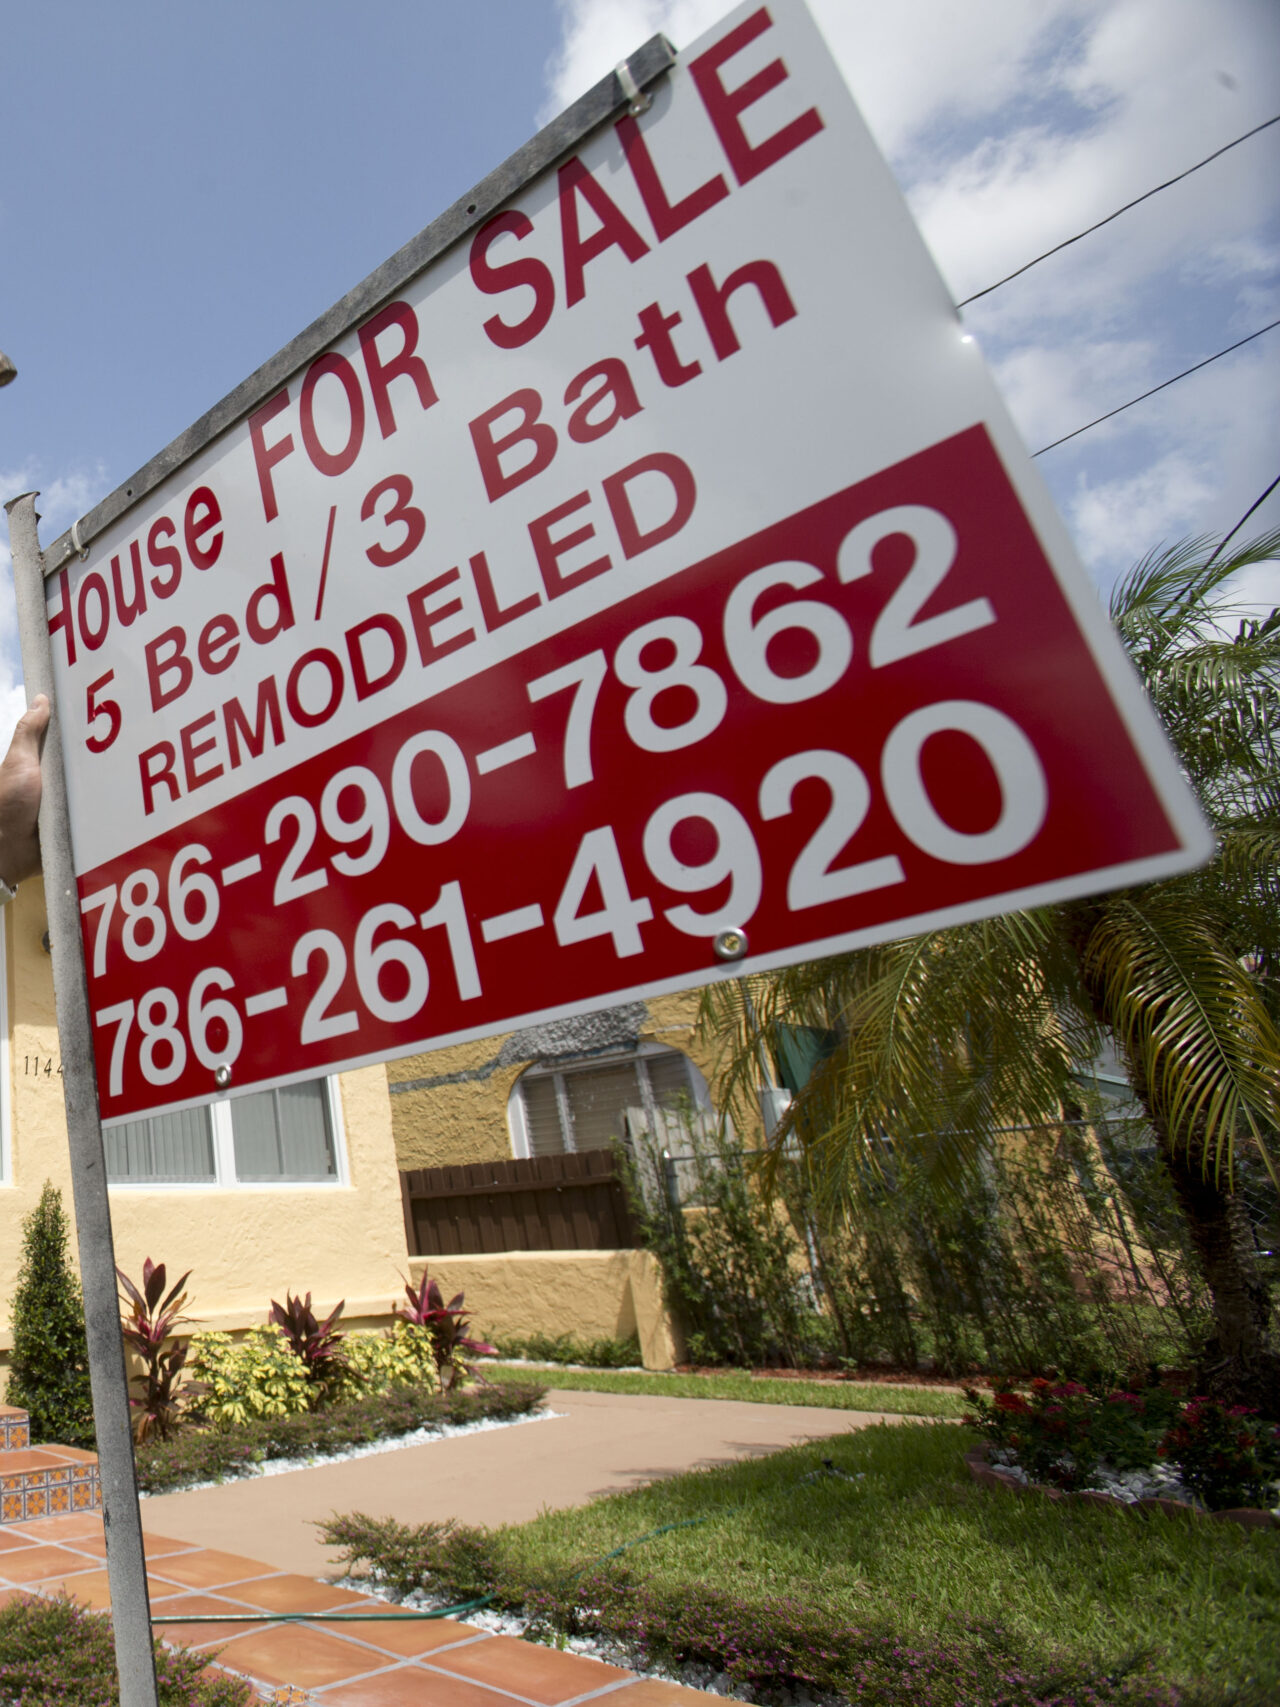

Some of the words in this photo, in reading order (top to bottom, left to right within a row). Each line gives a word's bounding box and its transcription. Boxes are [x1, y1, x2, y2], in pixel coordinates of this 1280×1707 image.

[48, 486, 224, 667] House
[247, 301, 440, 523] FOR
[469, 6, 825, 350] SALE
[85, 669, 122, 754] 5
[468, 259, 798, 503] Bath
[81, 505, 997, 979] 786-290-7862
[138, 452, 697, 816] REMODELED
[96, 700, 1048, 1098] 786-261-4920
